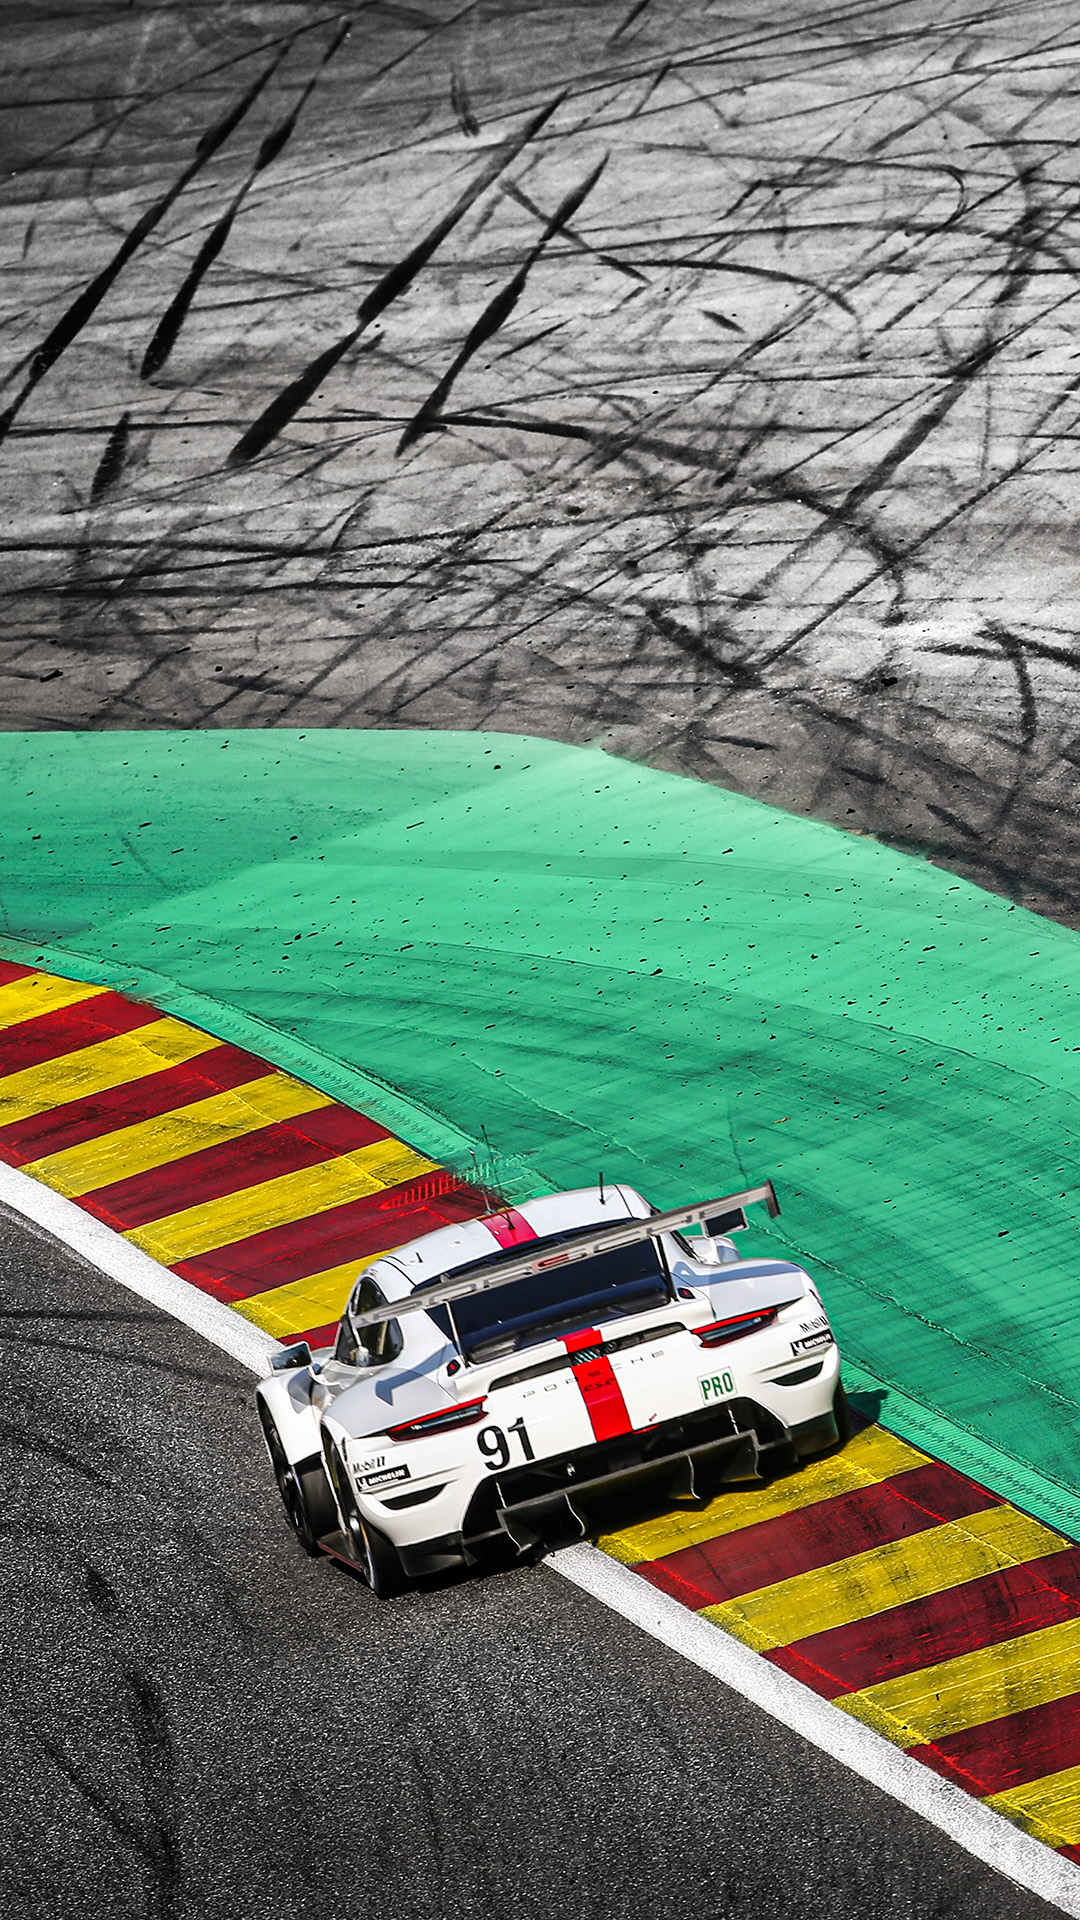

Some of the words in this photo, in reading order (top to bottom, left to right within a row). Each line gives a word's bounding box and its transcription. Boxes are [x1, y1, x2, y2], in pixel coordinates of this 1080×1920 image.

[369, 1196, 750, 1321] PORSCHE
[522, 1350, 666, 1398] PORSCHE
[700, 1372, 734, 1401] PRO
[353, 1458, 376, 1474] Mobil
[477, 1417, 536, 1471] 91
